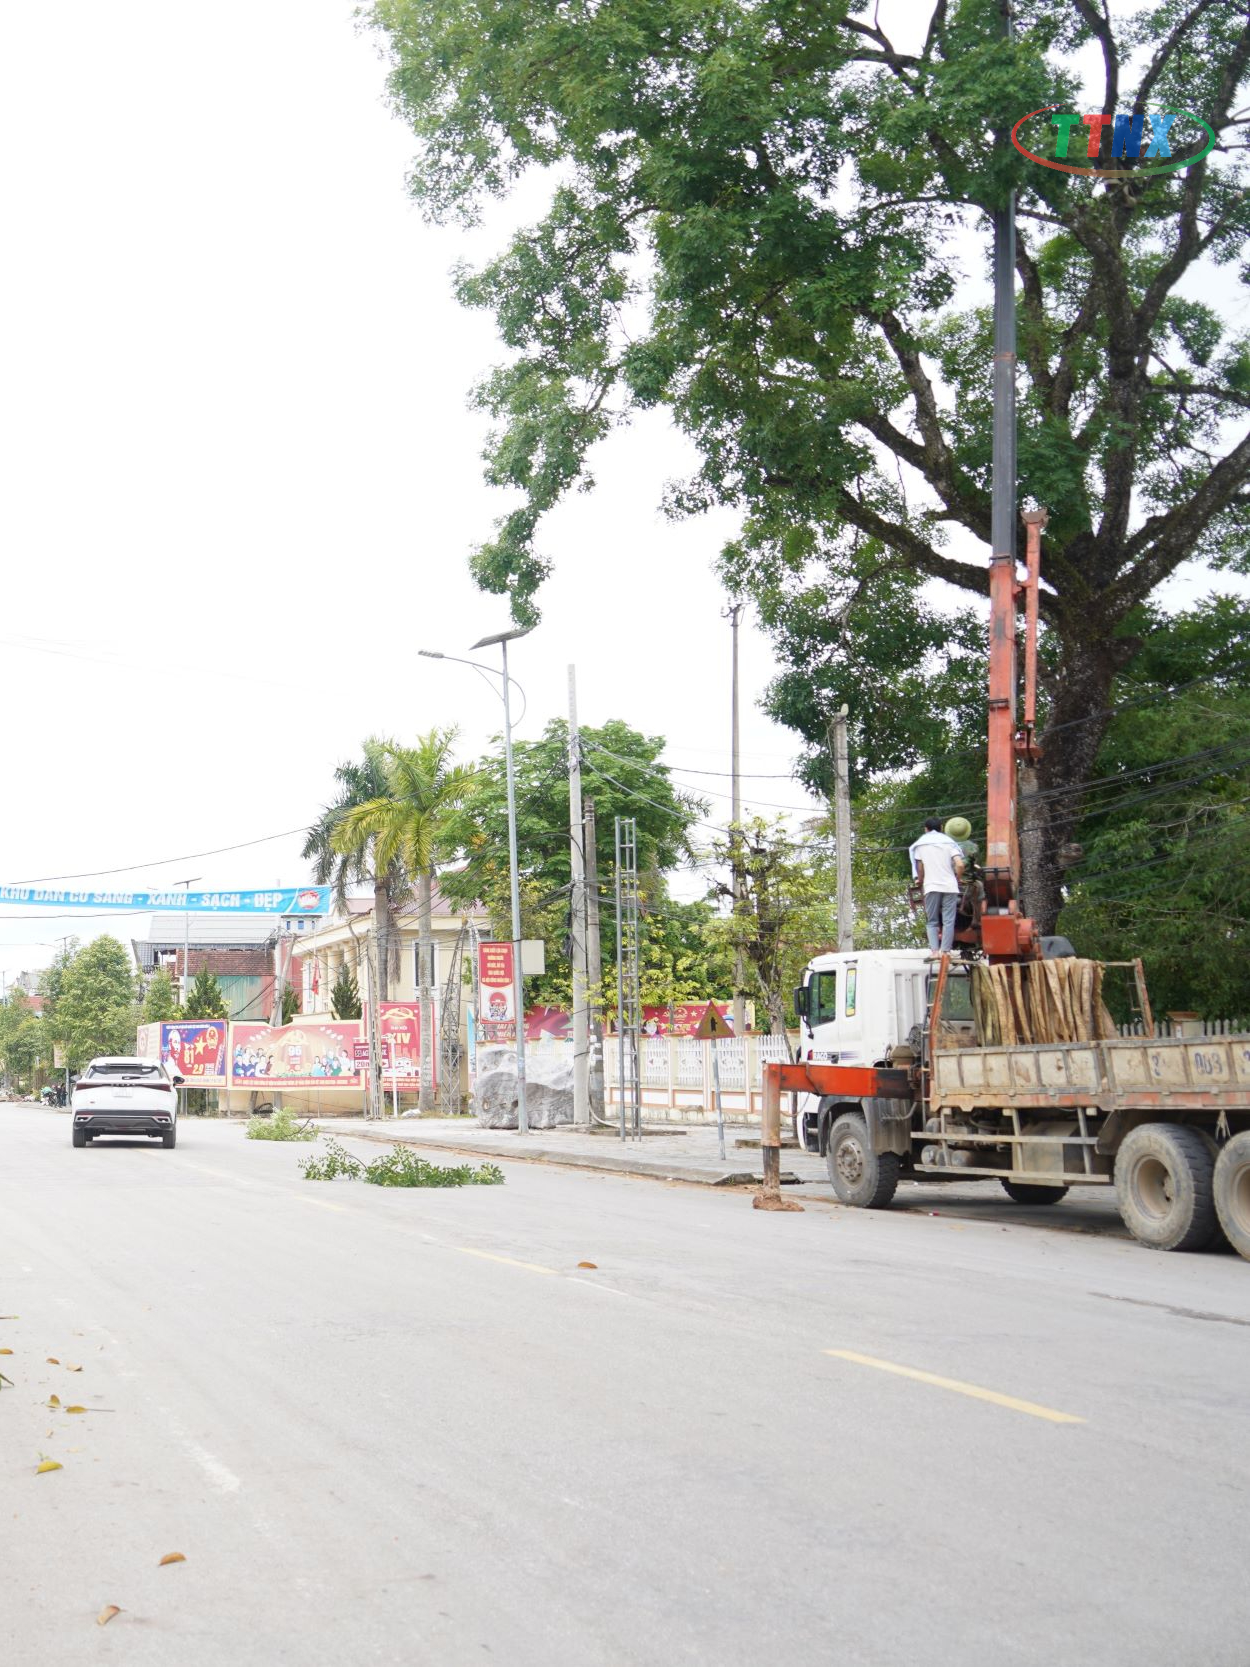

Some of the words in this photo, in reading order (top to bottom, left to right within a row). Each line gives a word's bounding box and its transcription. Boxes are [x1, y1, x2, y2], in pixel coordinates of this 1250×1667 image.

[0, 886, 29, 900] KHU
[147, 893, 186, 906] XANH
[201, 893, 240, 910] SẠCH
